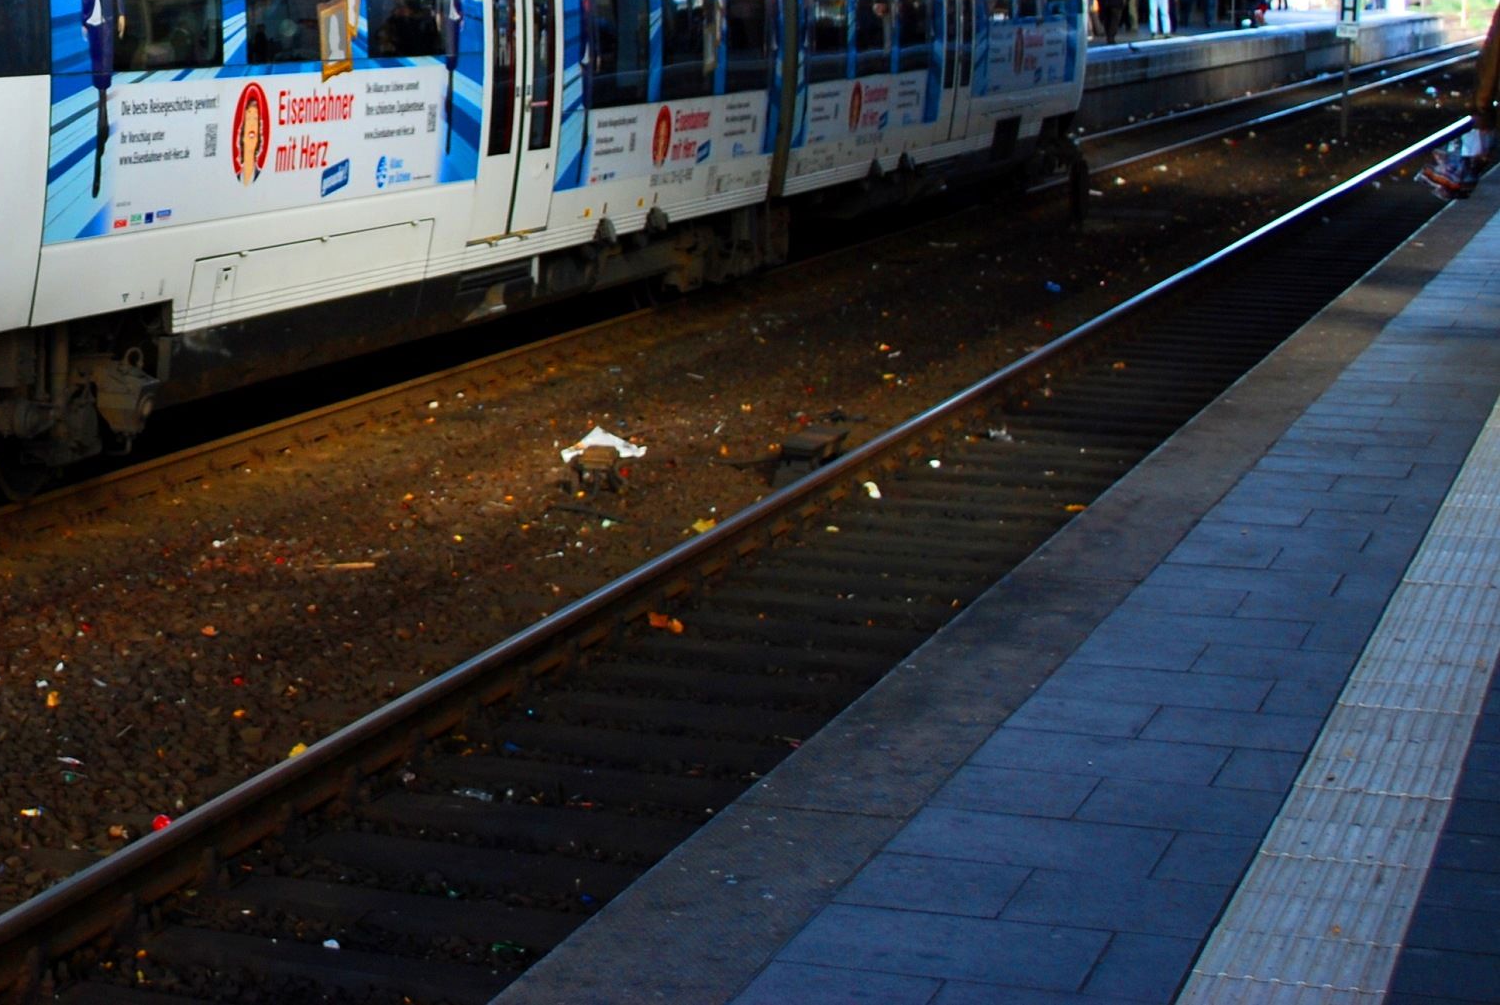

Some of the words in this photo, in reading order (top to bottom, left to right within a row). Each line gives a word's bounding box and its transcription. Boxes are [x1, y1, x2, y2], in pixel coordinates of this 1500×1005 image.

[278, 86, 355, 126] Eisenbahner
[275, 136, 297, 172] mit
[299, 133, 329, 170] Herz
